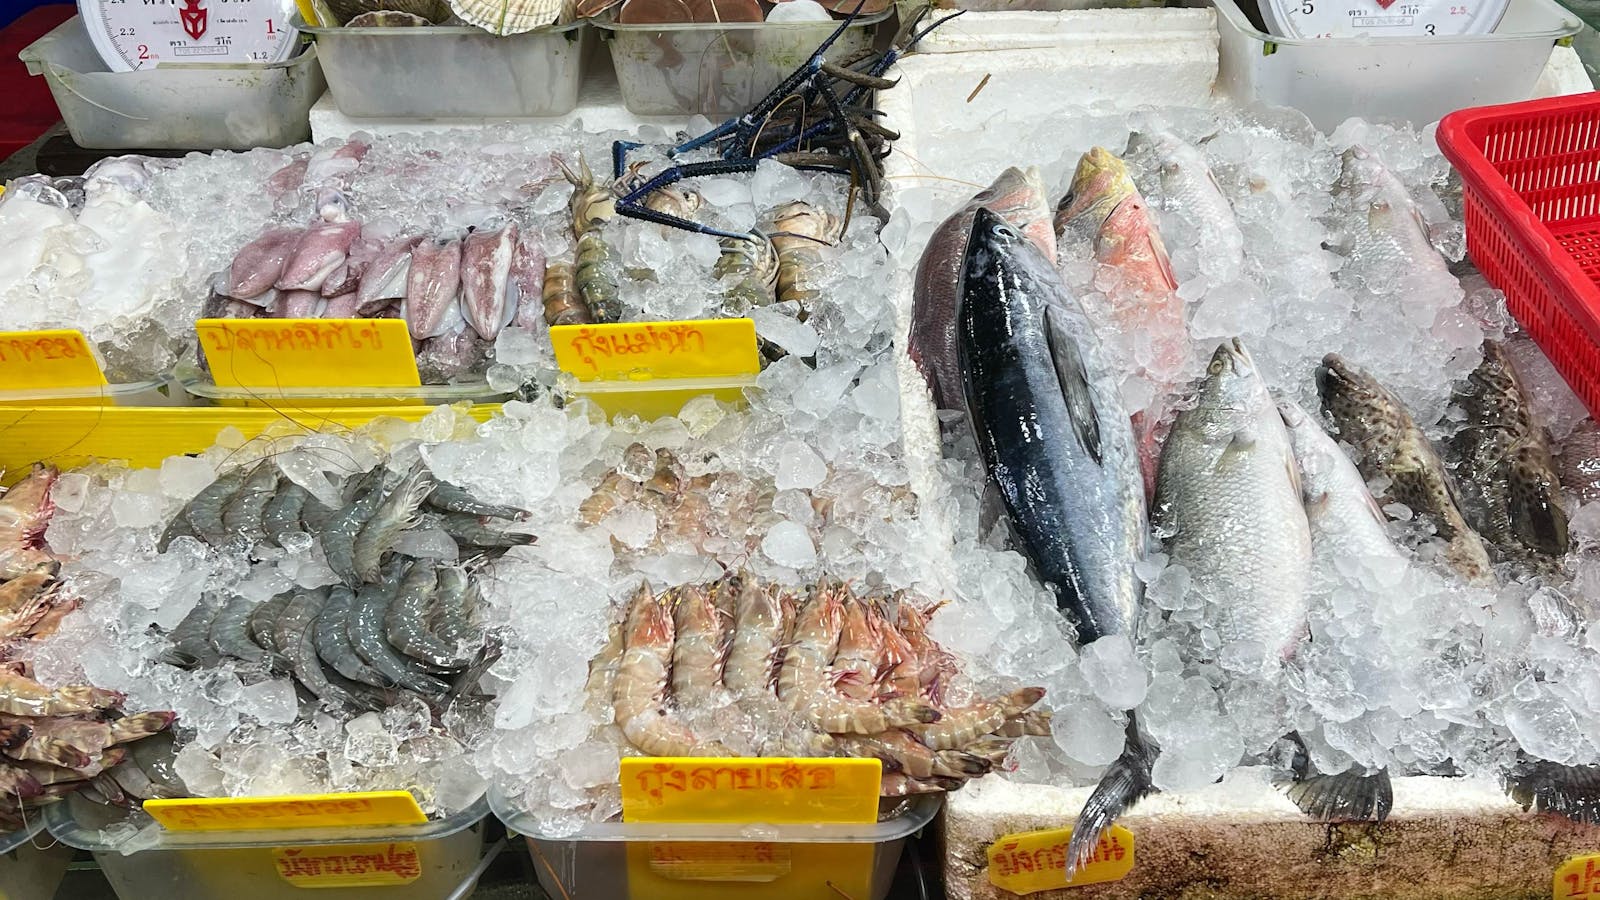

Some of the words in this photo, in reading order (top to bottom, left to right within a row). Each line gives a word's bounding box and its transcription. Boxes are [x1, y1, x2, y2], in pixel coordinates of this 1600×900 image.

[1302, 0, 1314, 14] 5
[1450, 6, 1467, 15] 2.5
[119, 27, 136, 36] 2.2
[265, 18, 276, 34] 1
[1424, 23, 1436, 36] 3
[137, 44, 150, 60] 2
[253, 51, 269, 60] 1.2
